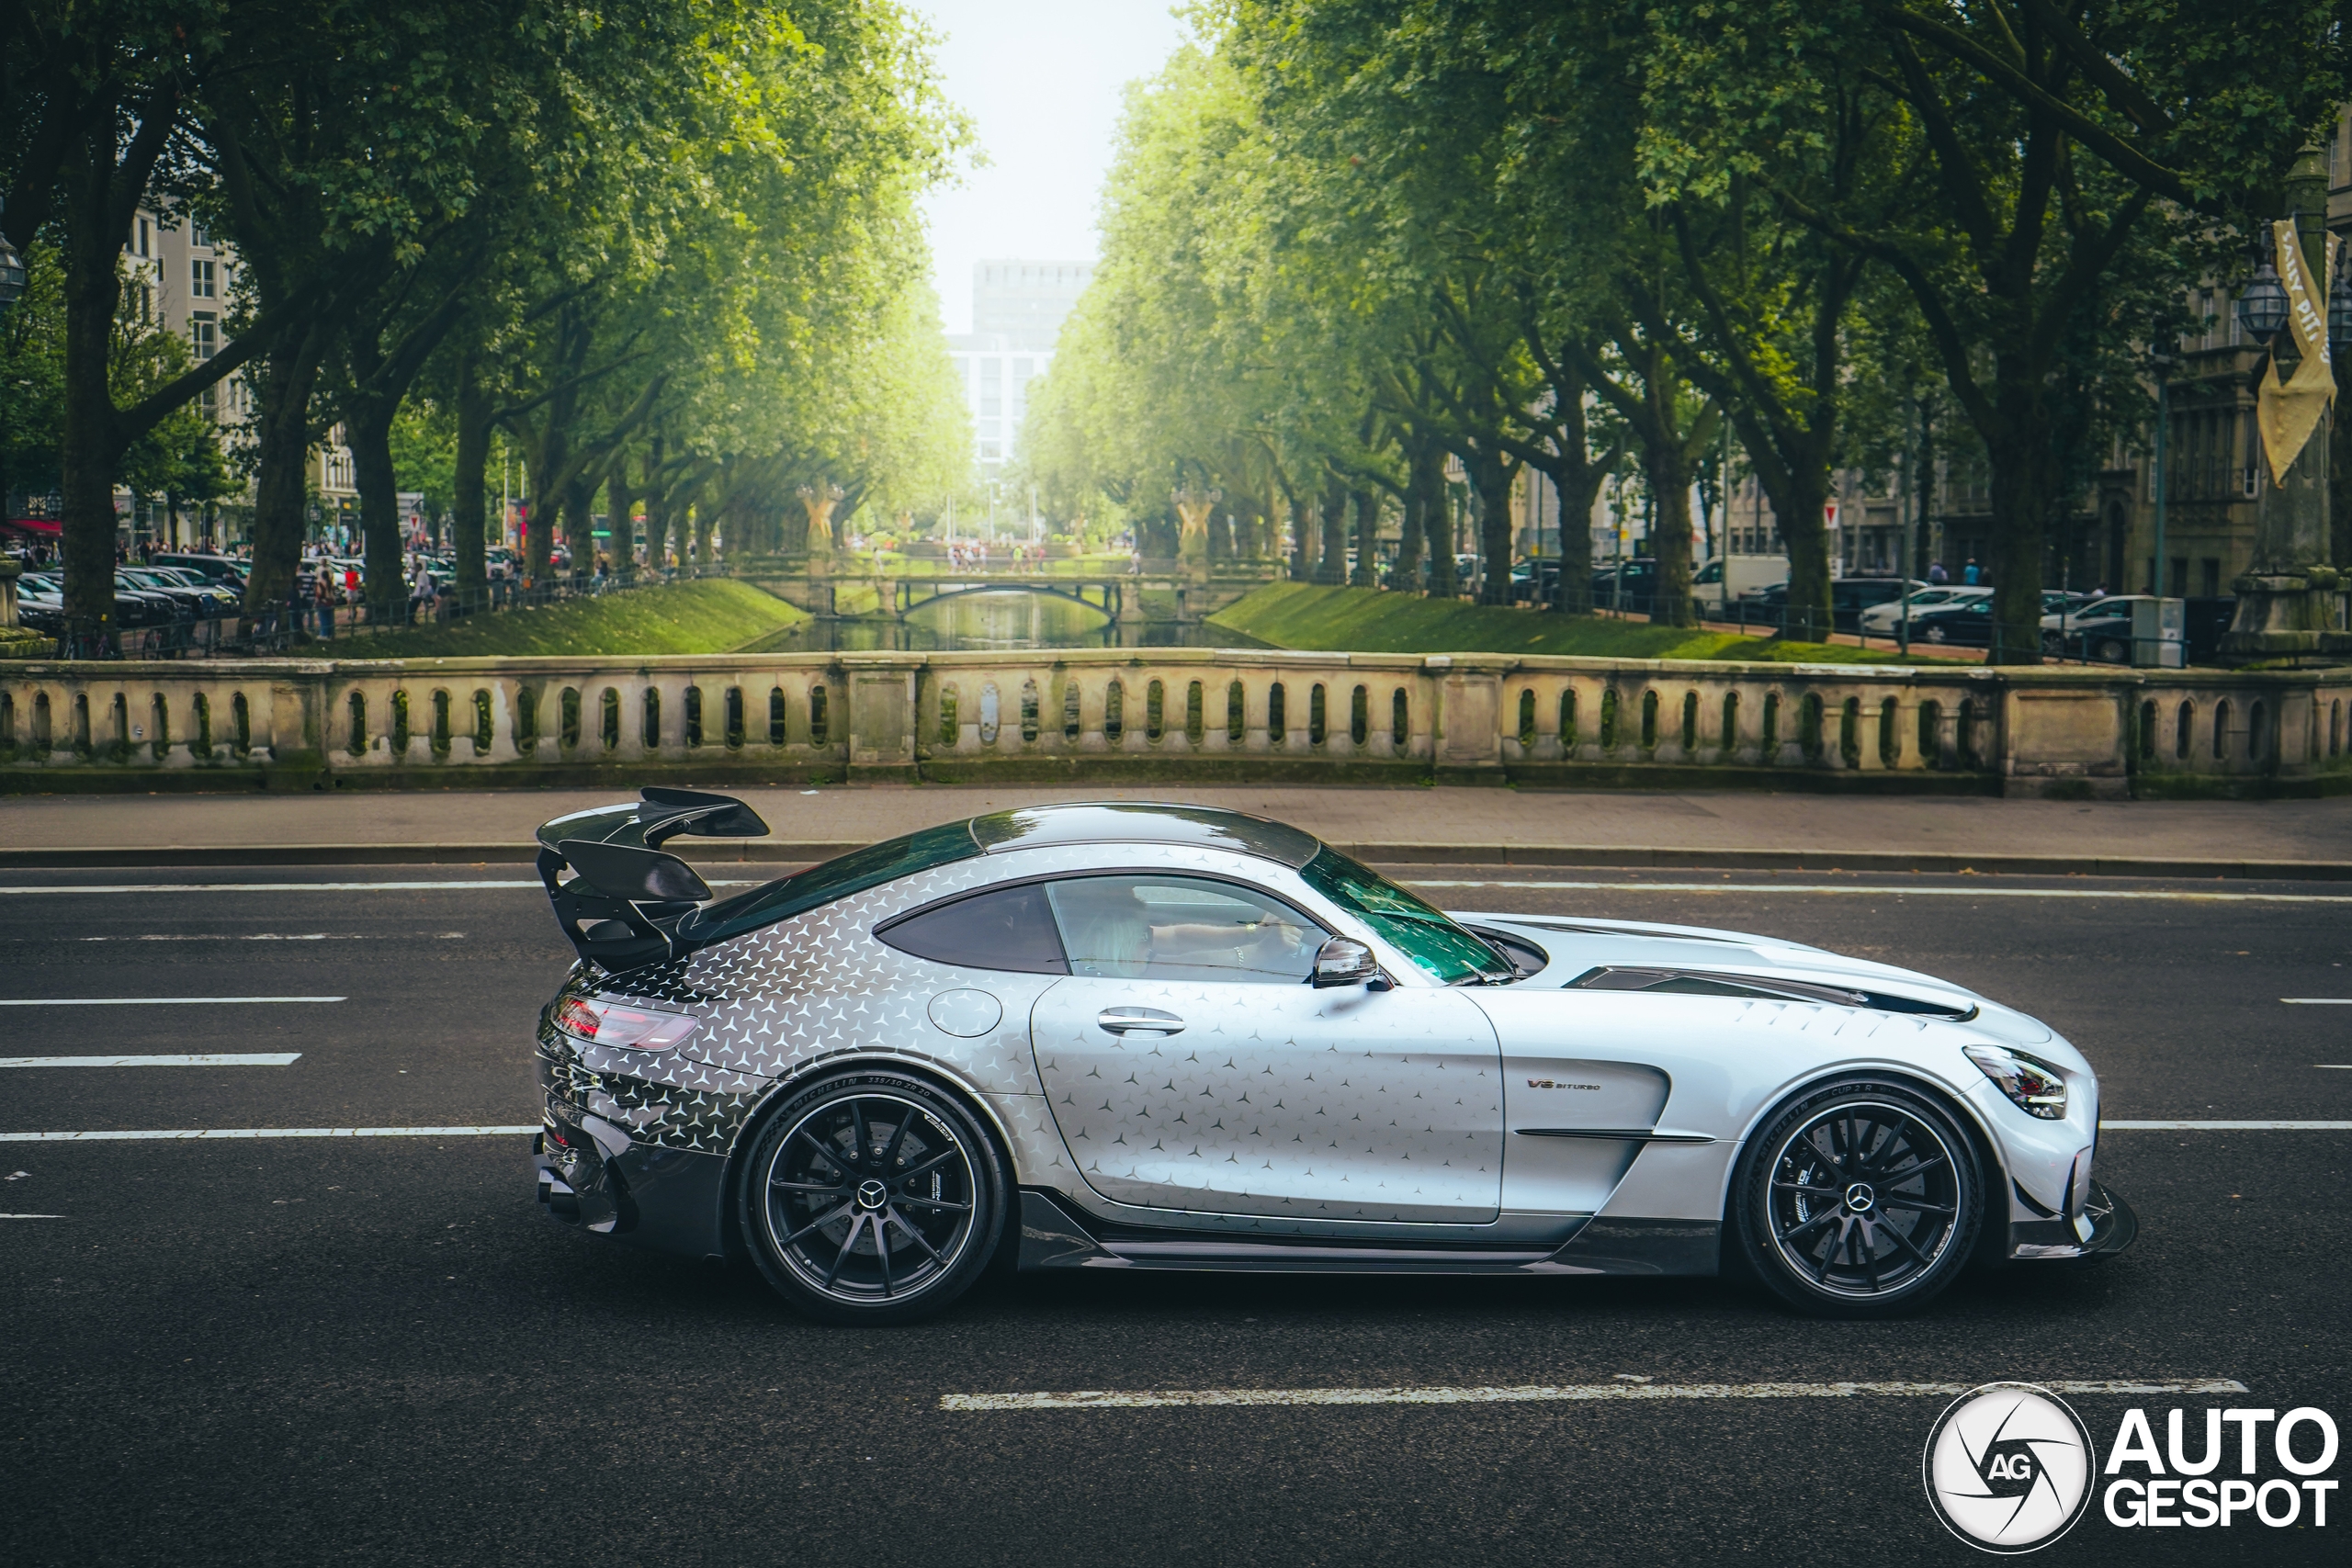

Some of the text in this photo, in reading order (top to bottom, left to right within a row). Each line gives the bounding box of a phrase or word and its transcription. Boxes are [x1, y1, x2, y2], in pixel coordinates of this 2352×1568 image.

[2282, 230, 2304, 291] SALLY
[794, 1076, 931, 1111] MICHELIN 335/30 ZR 20
[1527, 1078, 1600, 1091] V8 BITURBO
[1760, 1101, 1809, 1159] MICHELIN
[1831, 1086, 1852, 1097] CUP
[1854, 1084, 1860, 1093] 2
[1864, 1084, 1872, 1092] R
